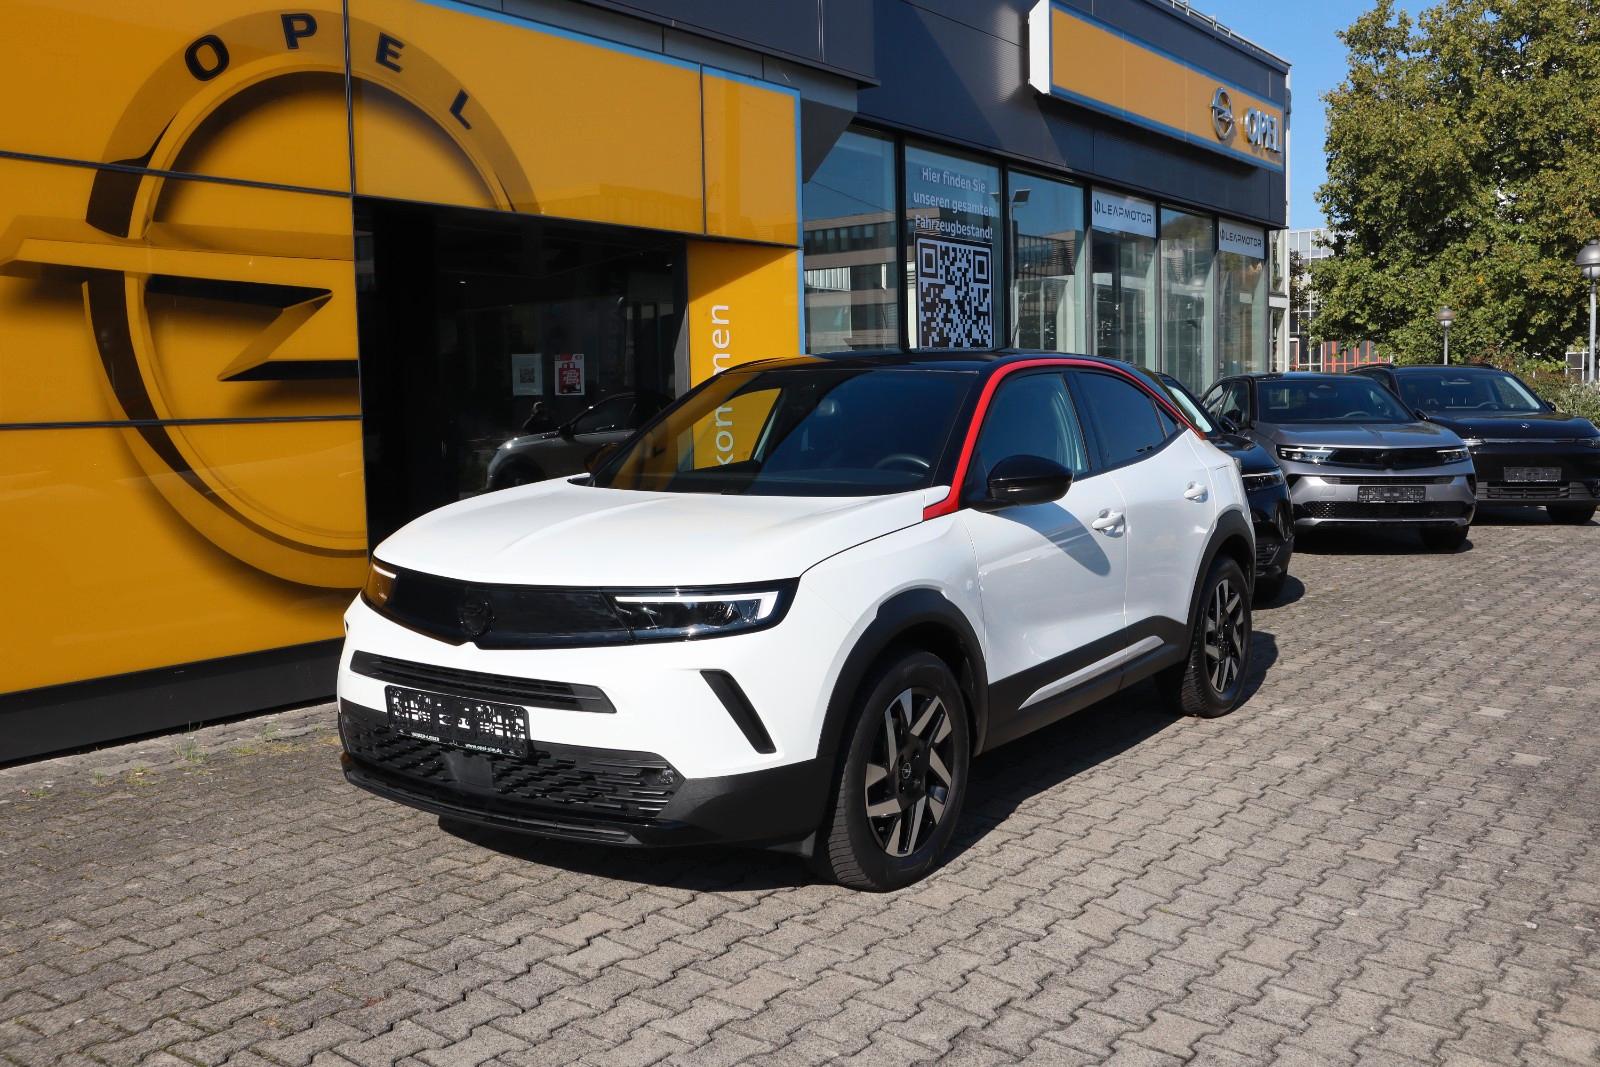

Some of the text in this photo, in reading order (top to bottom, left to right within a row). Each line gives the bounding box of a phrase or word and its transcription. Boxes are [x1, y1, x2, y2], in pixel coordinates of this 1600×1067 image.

[184, 13, 472, 130] OPEL
[1244, 106, 1281, 153] OPEL
[922, 168, 986, 192] Hier finden Sie
[913, 191, 994, 217] unseren gesamten
[1101, 202, 1152, 225] LEAPMOTOR
[914, 214, 993, 240] Fahrzeugbestand!
[1225, 231, 1262, 249] LEAPMOTOR
